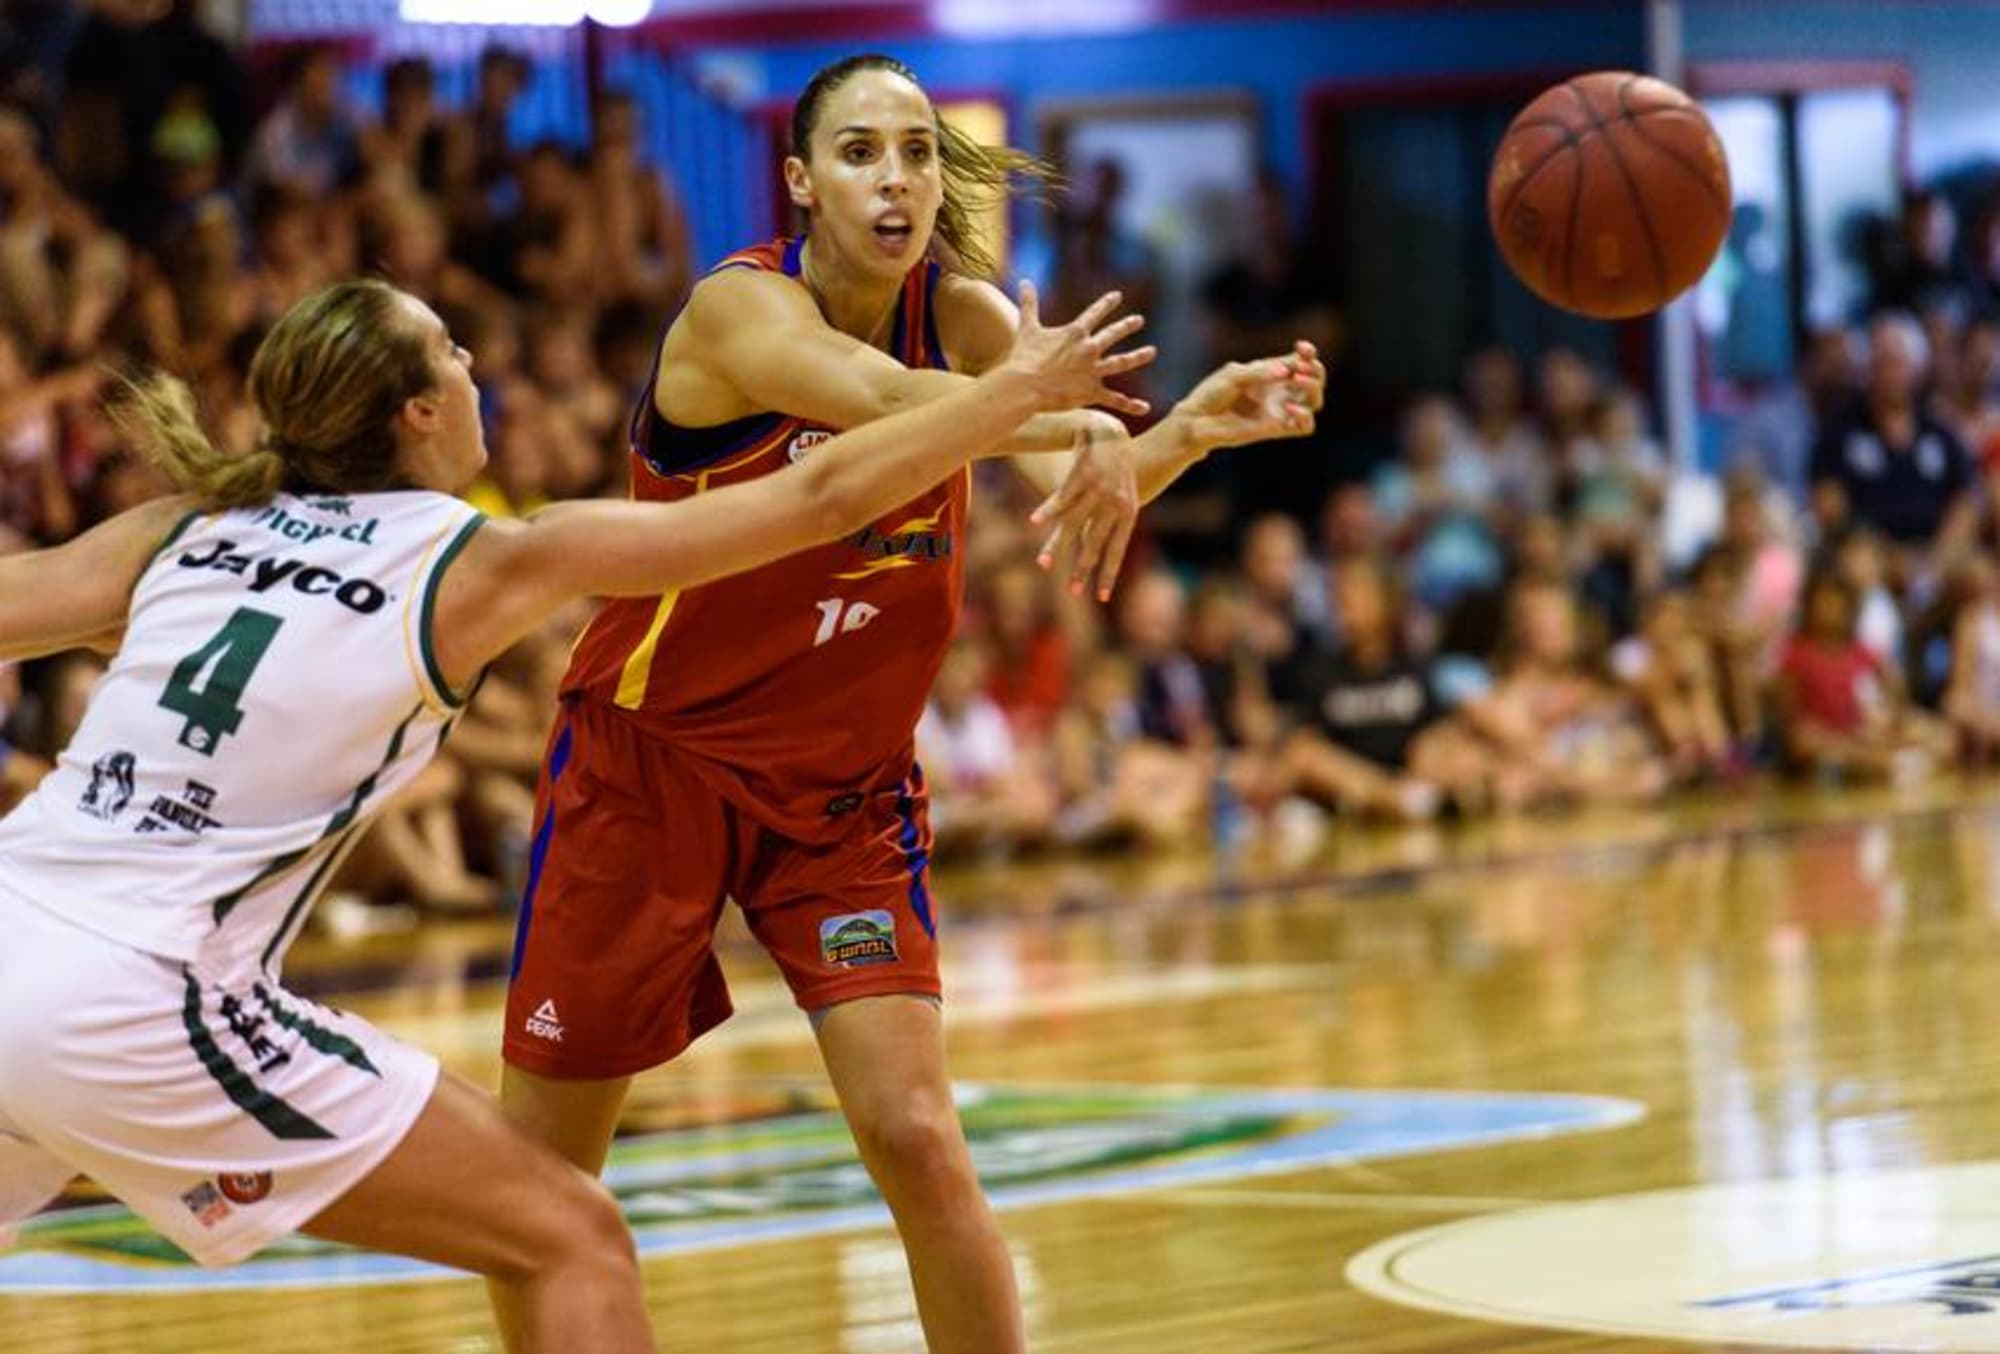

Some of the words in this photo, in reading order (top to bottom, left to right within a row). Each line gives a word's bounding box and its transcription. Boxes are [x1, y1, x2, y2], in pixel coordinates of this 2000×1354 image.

[178, 540, 386, 614] Jayco
[157, 605, 284, 757] 4
[526, 1017, 565, 1042] PEAK
